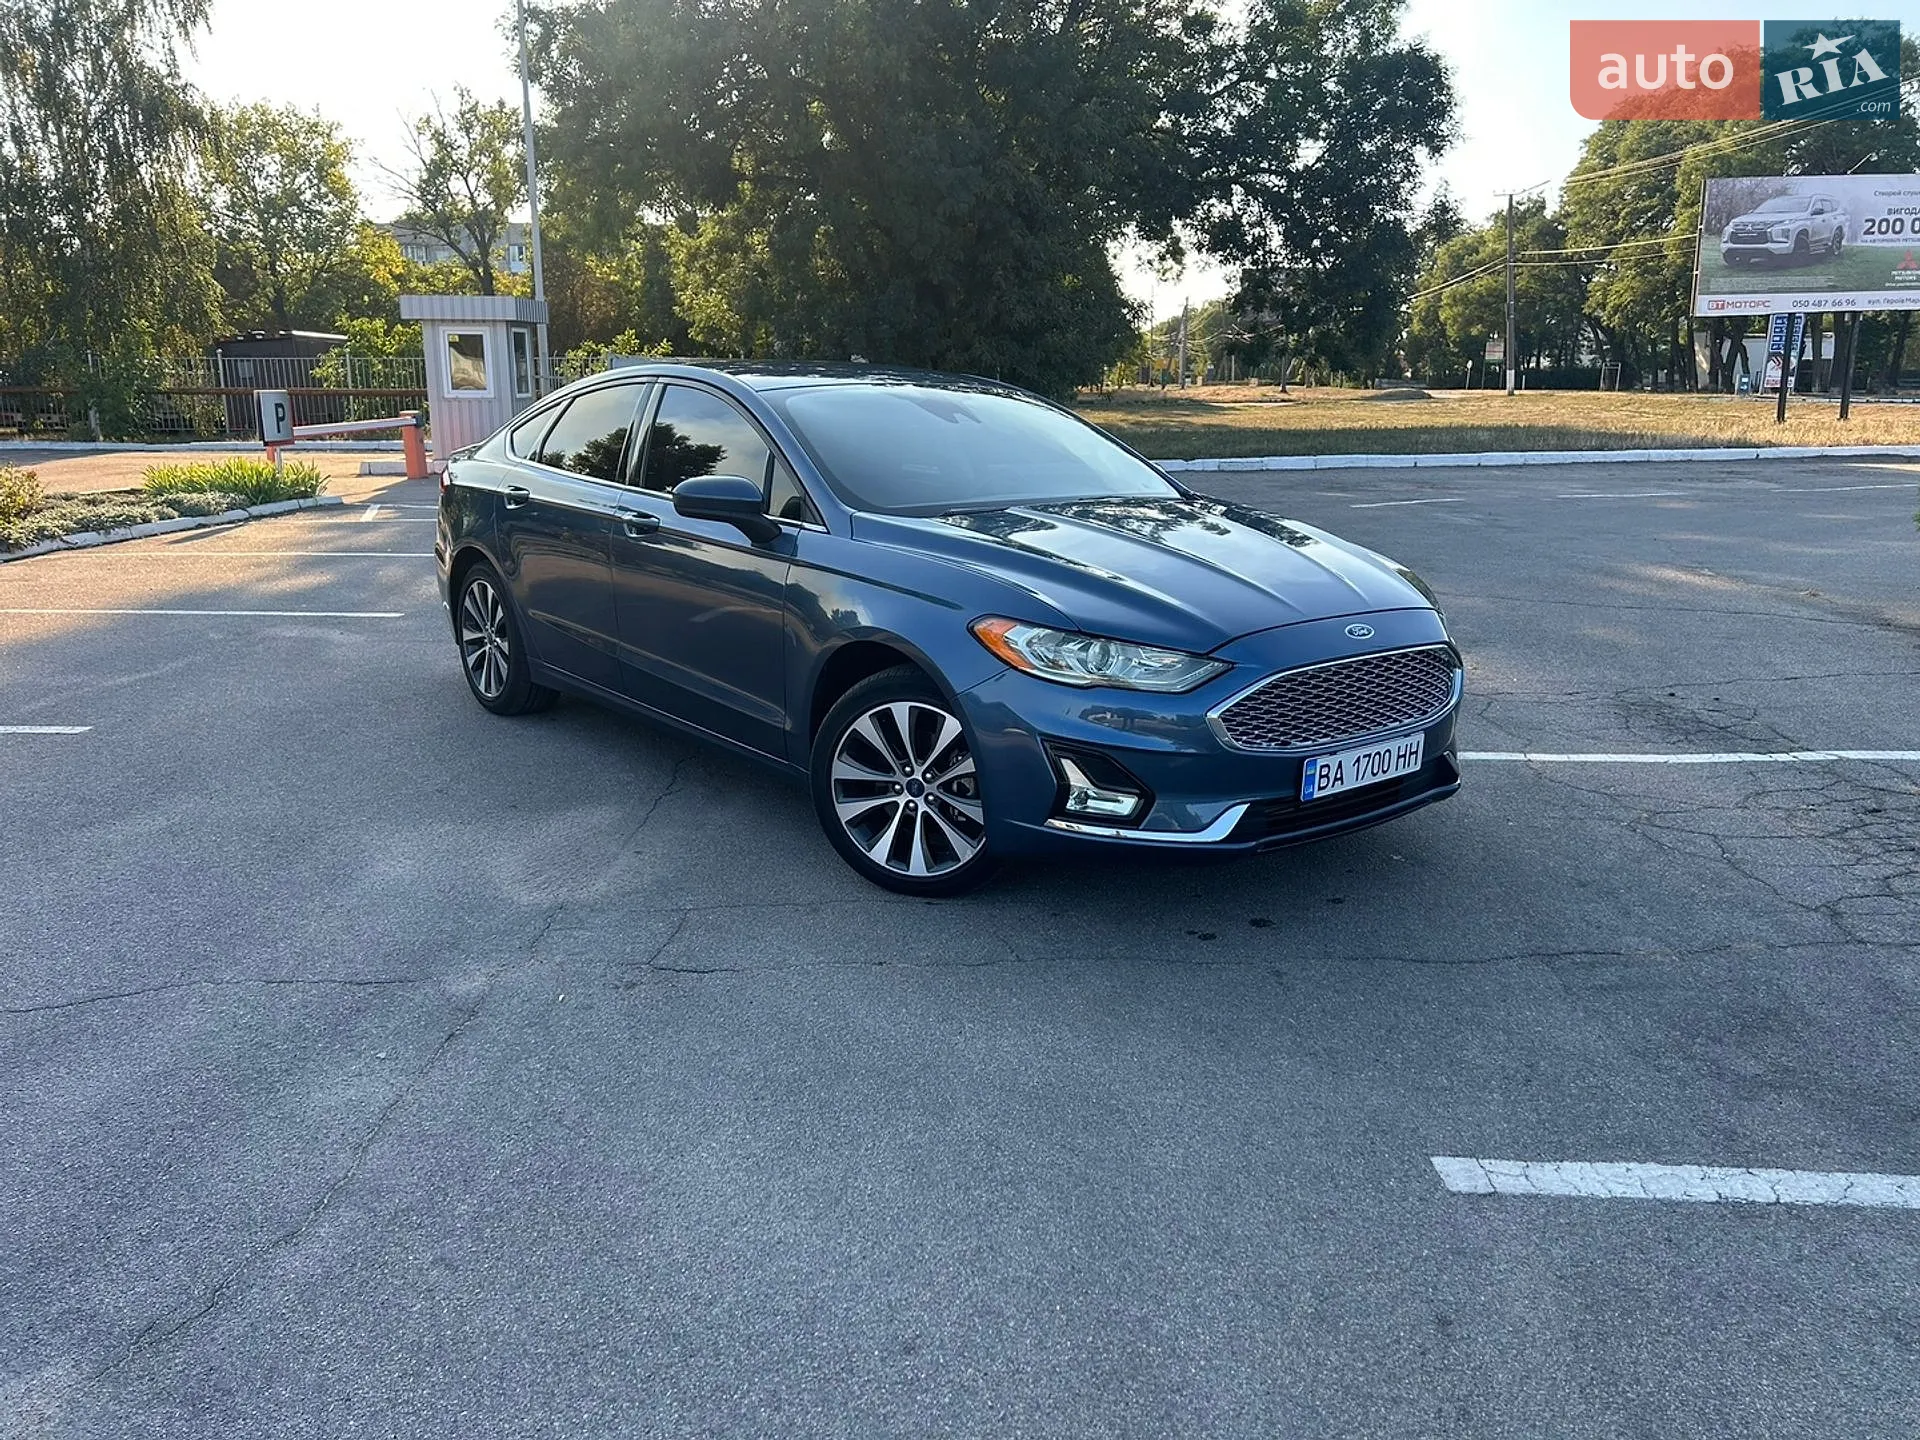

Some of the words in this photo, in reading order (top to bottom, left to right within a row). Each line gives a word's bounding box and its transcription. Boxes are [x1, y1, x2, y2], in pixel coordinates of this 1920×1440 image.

[1863, 218, 1905, 236] 200
[1792, 300, 1809, 308] 050
[1811, 299, 1828, 307] 487
[1831, 299, 1842, 307] 66
[1845, 298, 1857, 306] 96
[275, 402, 285, 433] P
[1317, 760, 1344, 791] BA
[1352, 749, 1391, 782] 1700
[1395, 740, 1420, 771] HH
